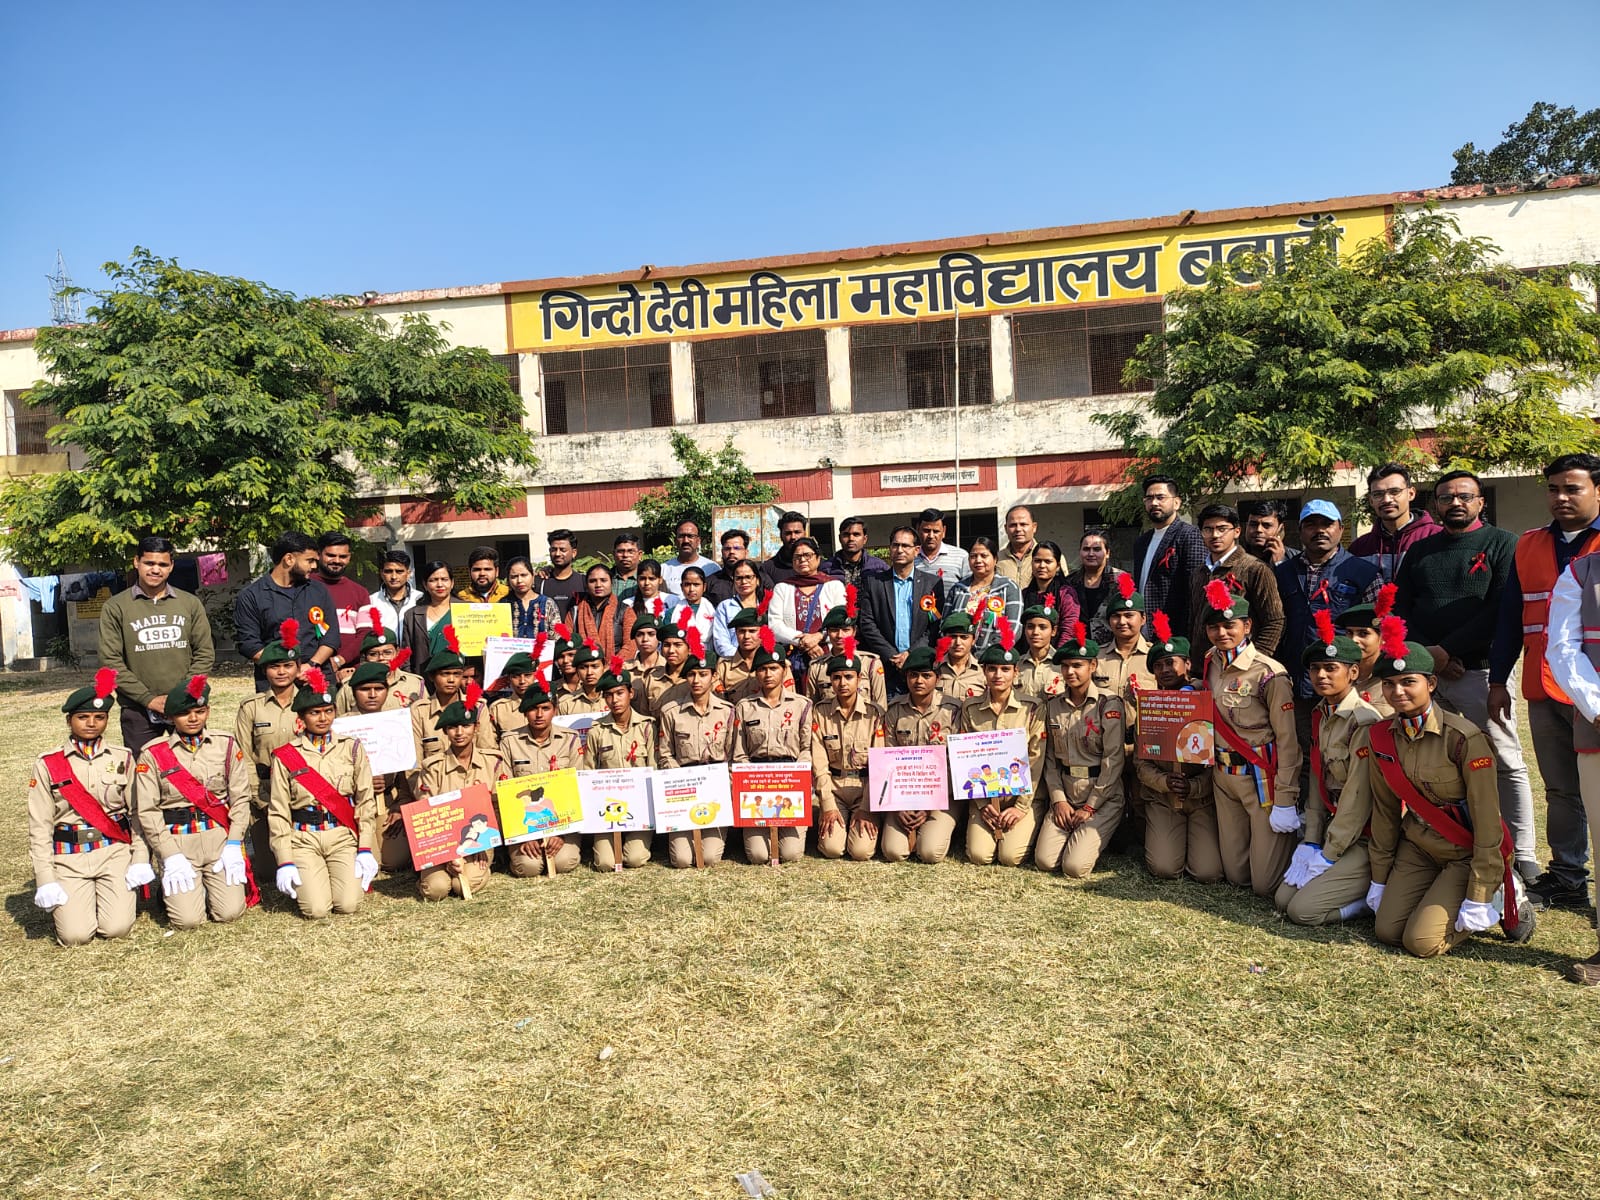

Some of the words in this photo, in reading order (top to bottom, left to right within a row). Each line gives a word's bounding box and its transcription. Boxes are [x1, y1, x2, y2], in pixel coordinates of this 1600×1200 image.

[539, 284, 645, 340] गिन्दो
[646, 278, 710, 334] देवी
[713, 271, 841, 328] महिला
[849, 245, 1162, 315] महाविद्यालय
[130, 614, 167, 631] MADE
[172, 615, 186, 626] IN
[145, 628, 177, 641] 1961
[1473, 758, 1489, 768] NCC
